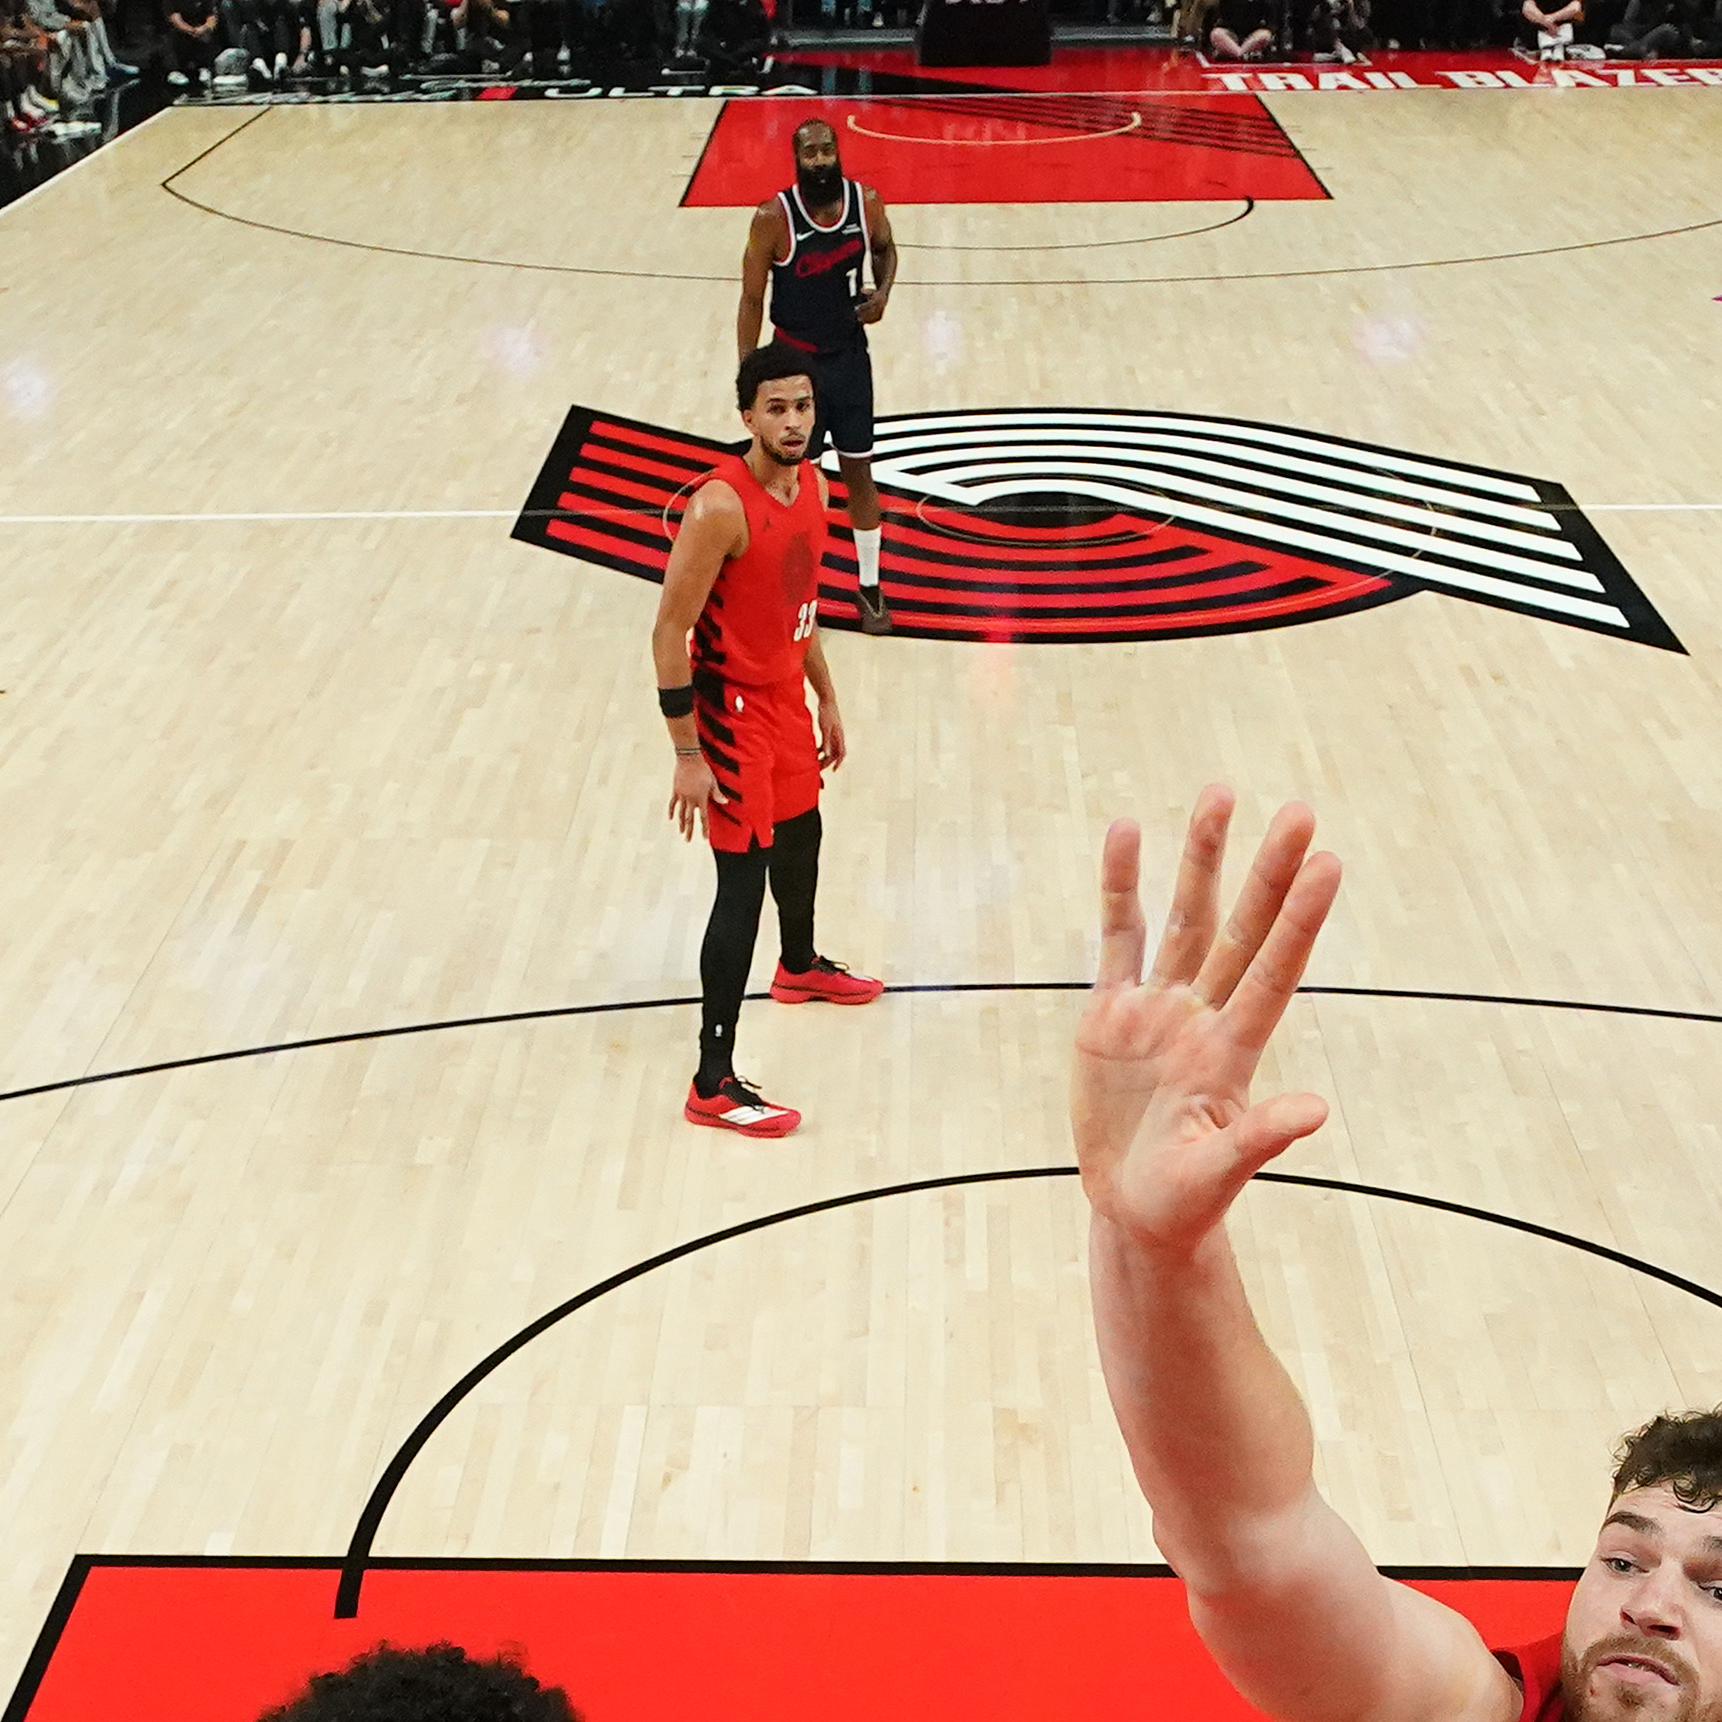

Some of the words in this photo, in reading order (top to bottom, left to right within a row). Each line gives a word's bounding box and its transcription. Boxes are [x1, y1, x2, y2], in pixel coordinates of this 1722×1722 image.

[543, 84, 819, 98] ULTRA
[1201, 71, 1441, 91] TRAIL
[845, 267, 857, 297] 1
[793, 599, 818, 642] 33
